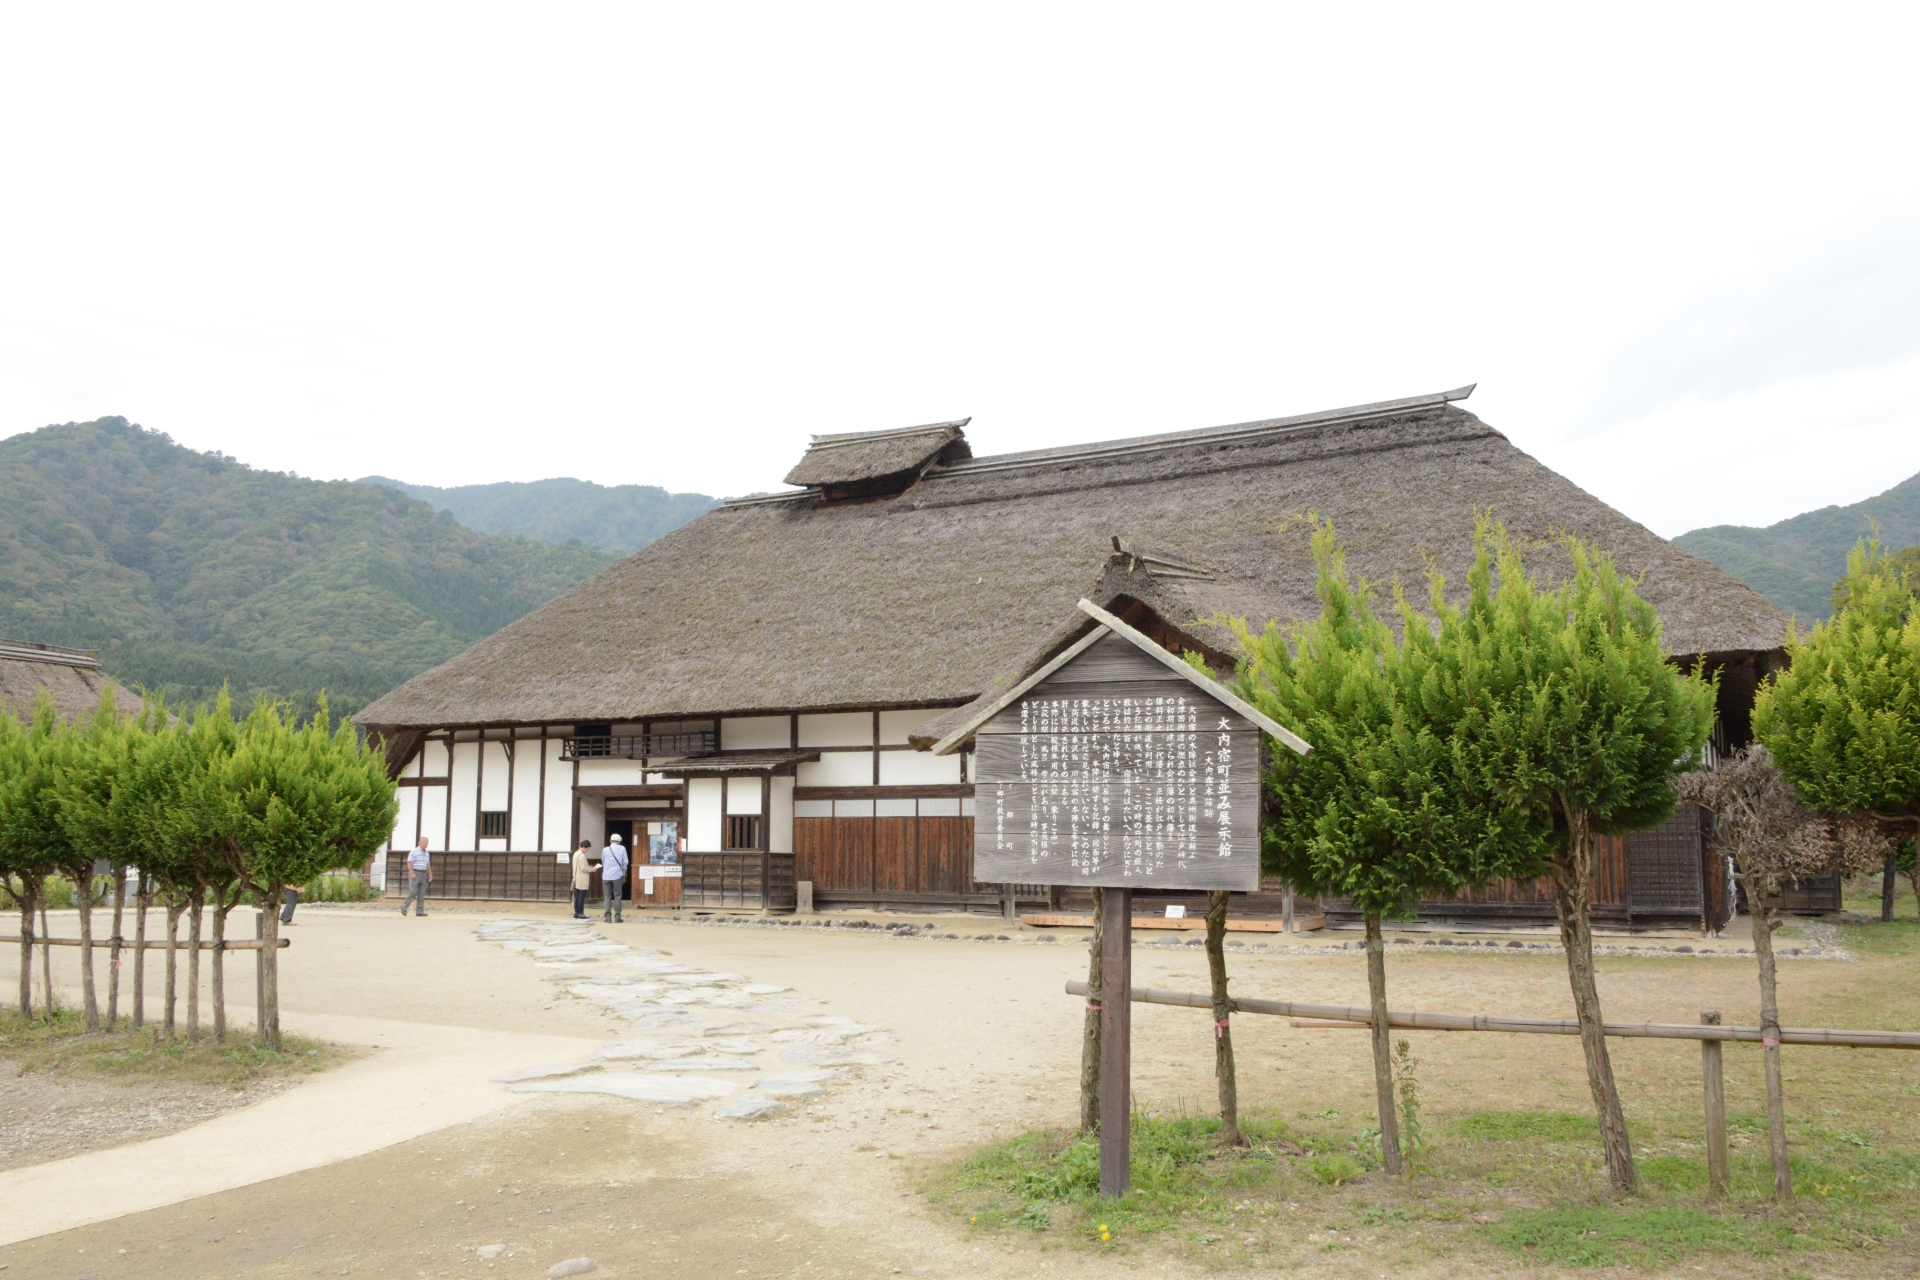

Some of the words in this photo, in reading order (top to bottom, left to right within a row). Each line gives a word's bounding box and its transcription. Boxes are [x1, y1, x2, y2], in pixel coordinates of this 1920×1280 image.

[1217, 717, 1232, 857] 大内宿町並み展示館
